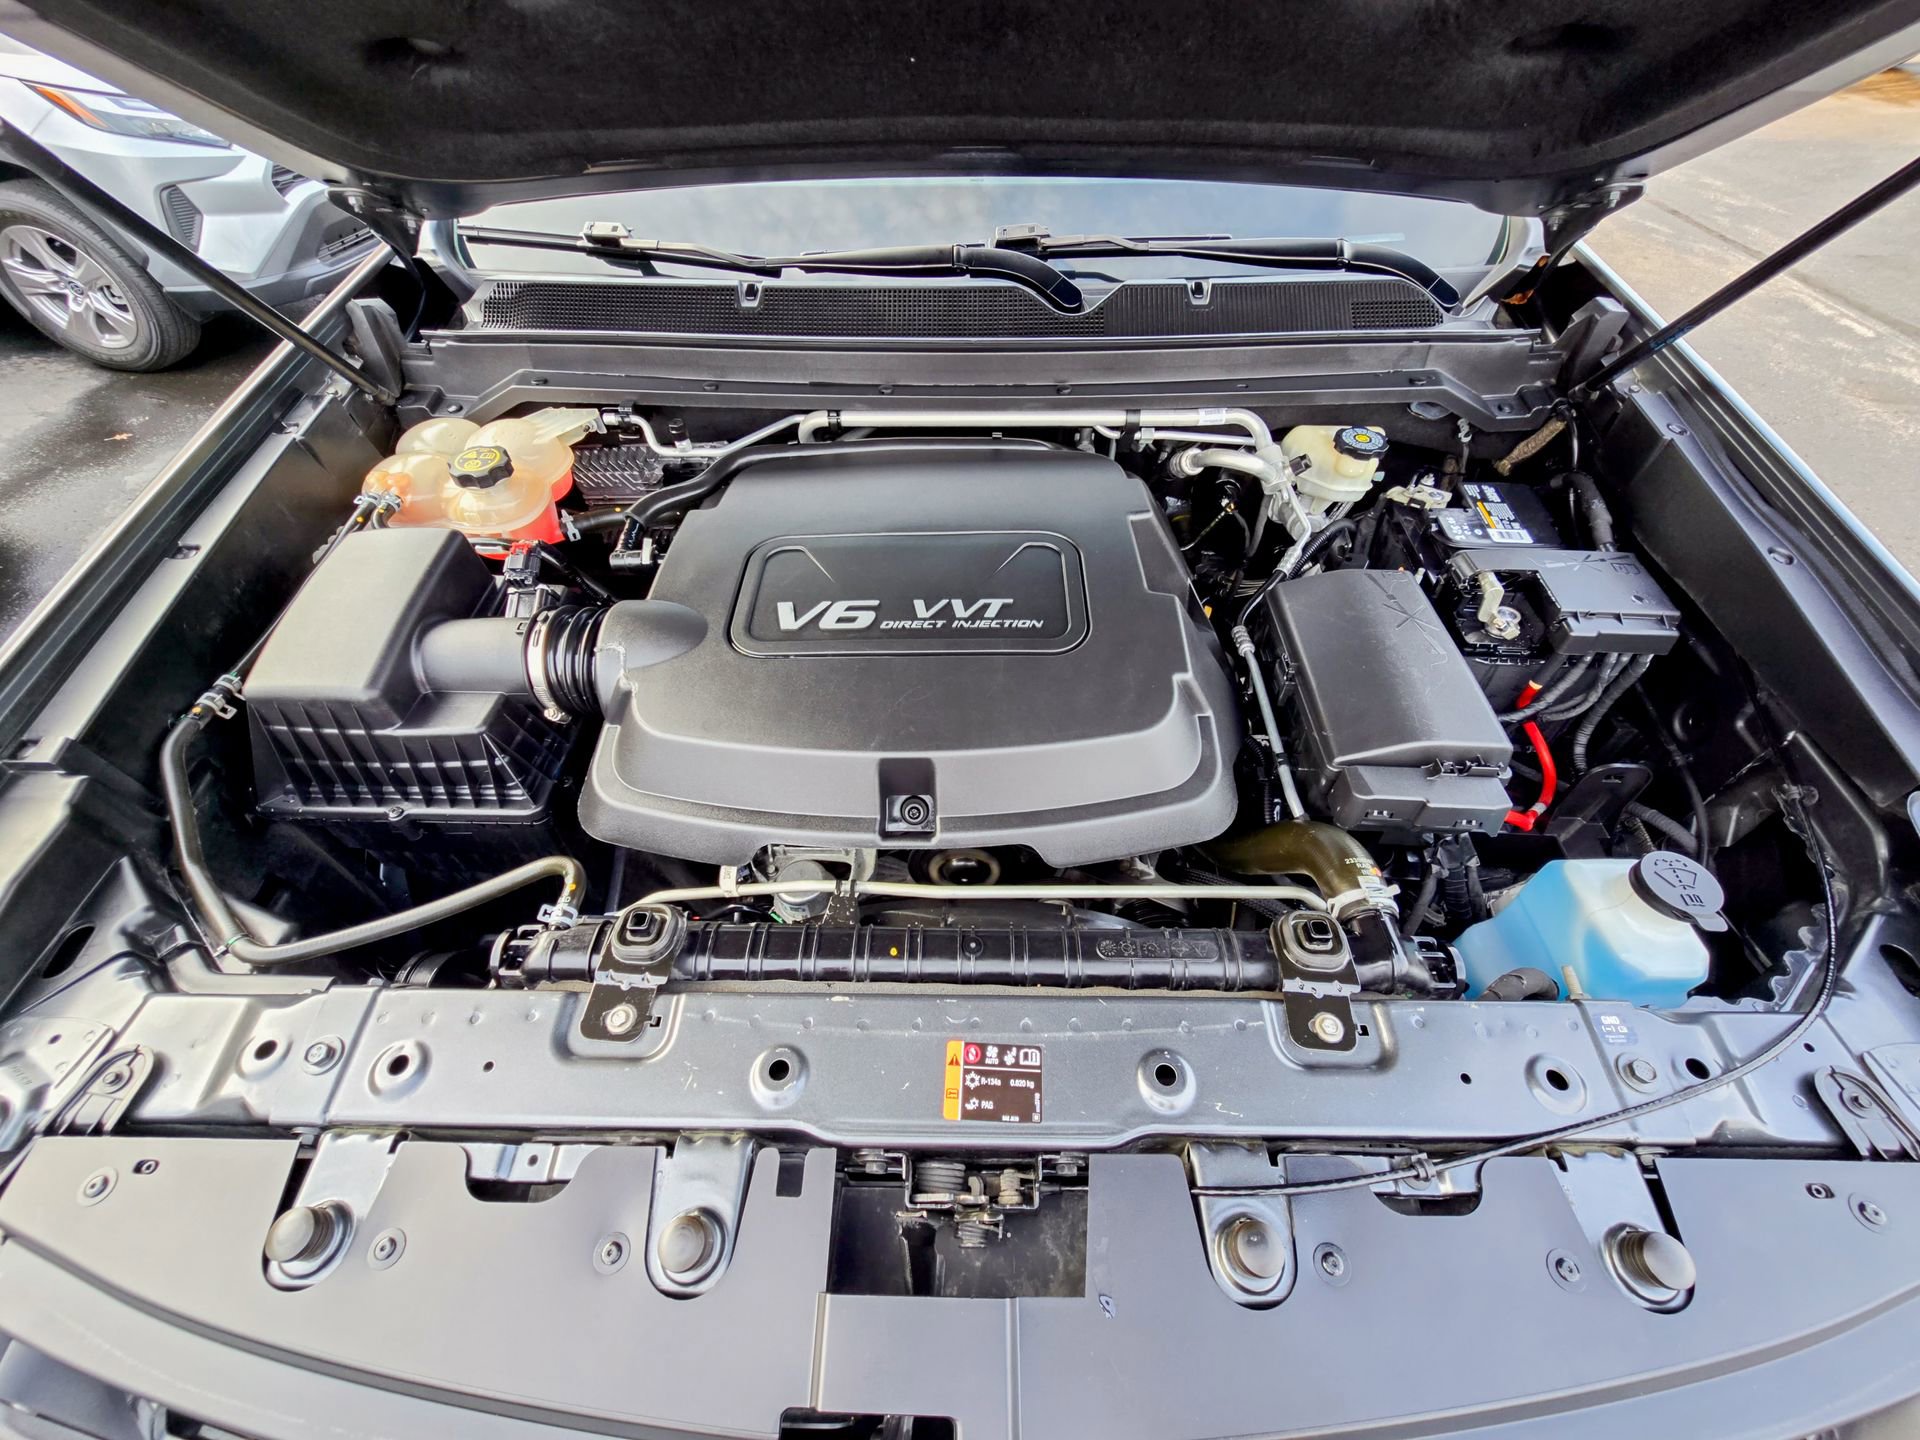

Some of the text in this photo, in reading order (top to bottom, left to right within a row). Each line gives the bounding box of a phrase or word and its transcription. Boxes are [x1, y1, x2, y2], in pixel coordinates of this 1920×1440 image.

[777, 598, 1014, 631] V6 VVT
[880, 619, 1044, 629] DIRECT INJECTION
[980, 1077, 1001, 1087] R-134a
[981, 1101, 994, 1109] PAG
